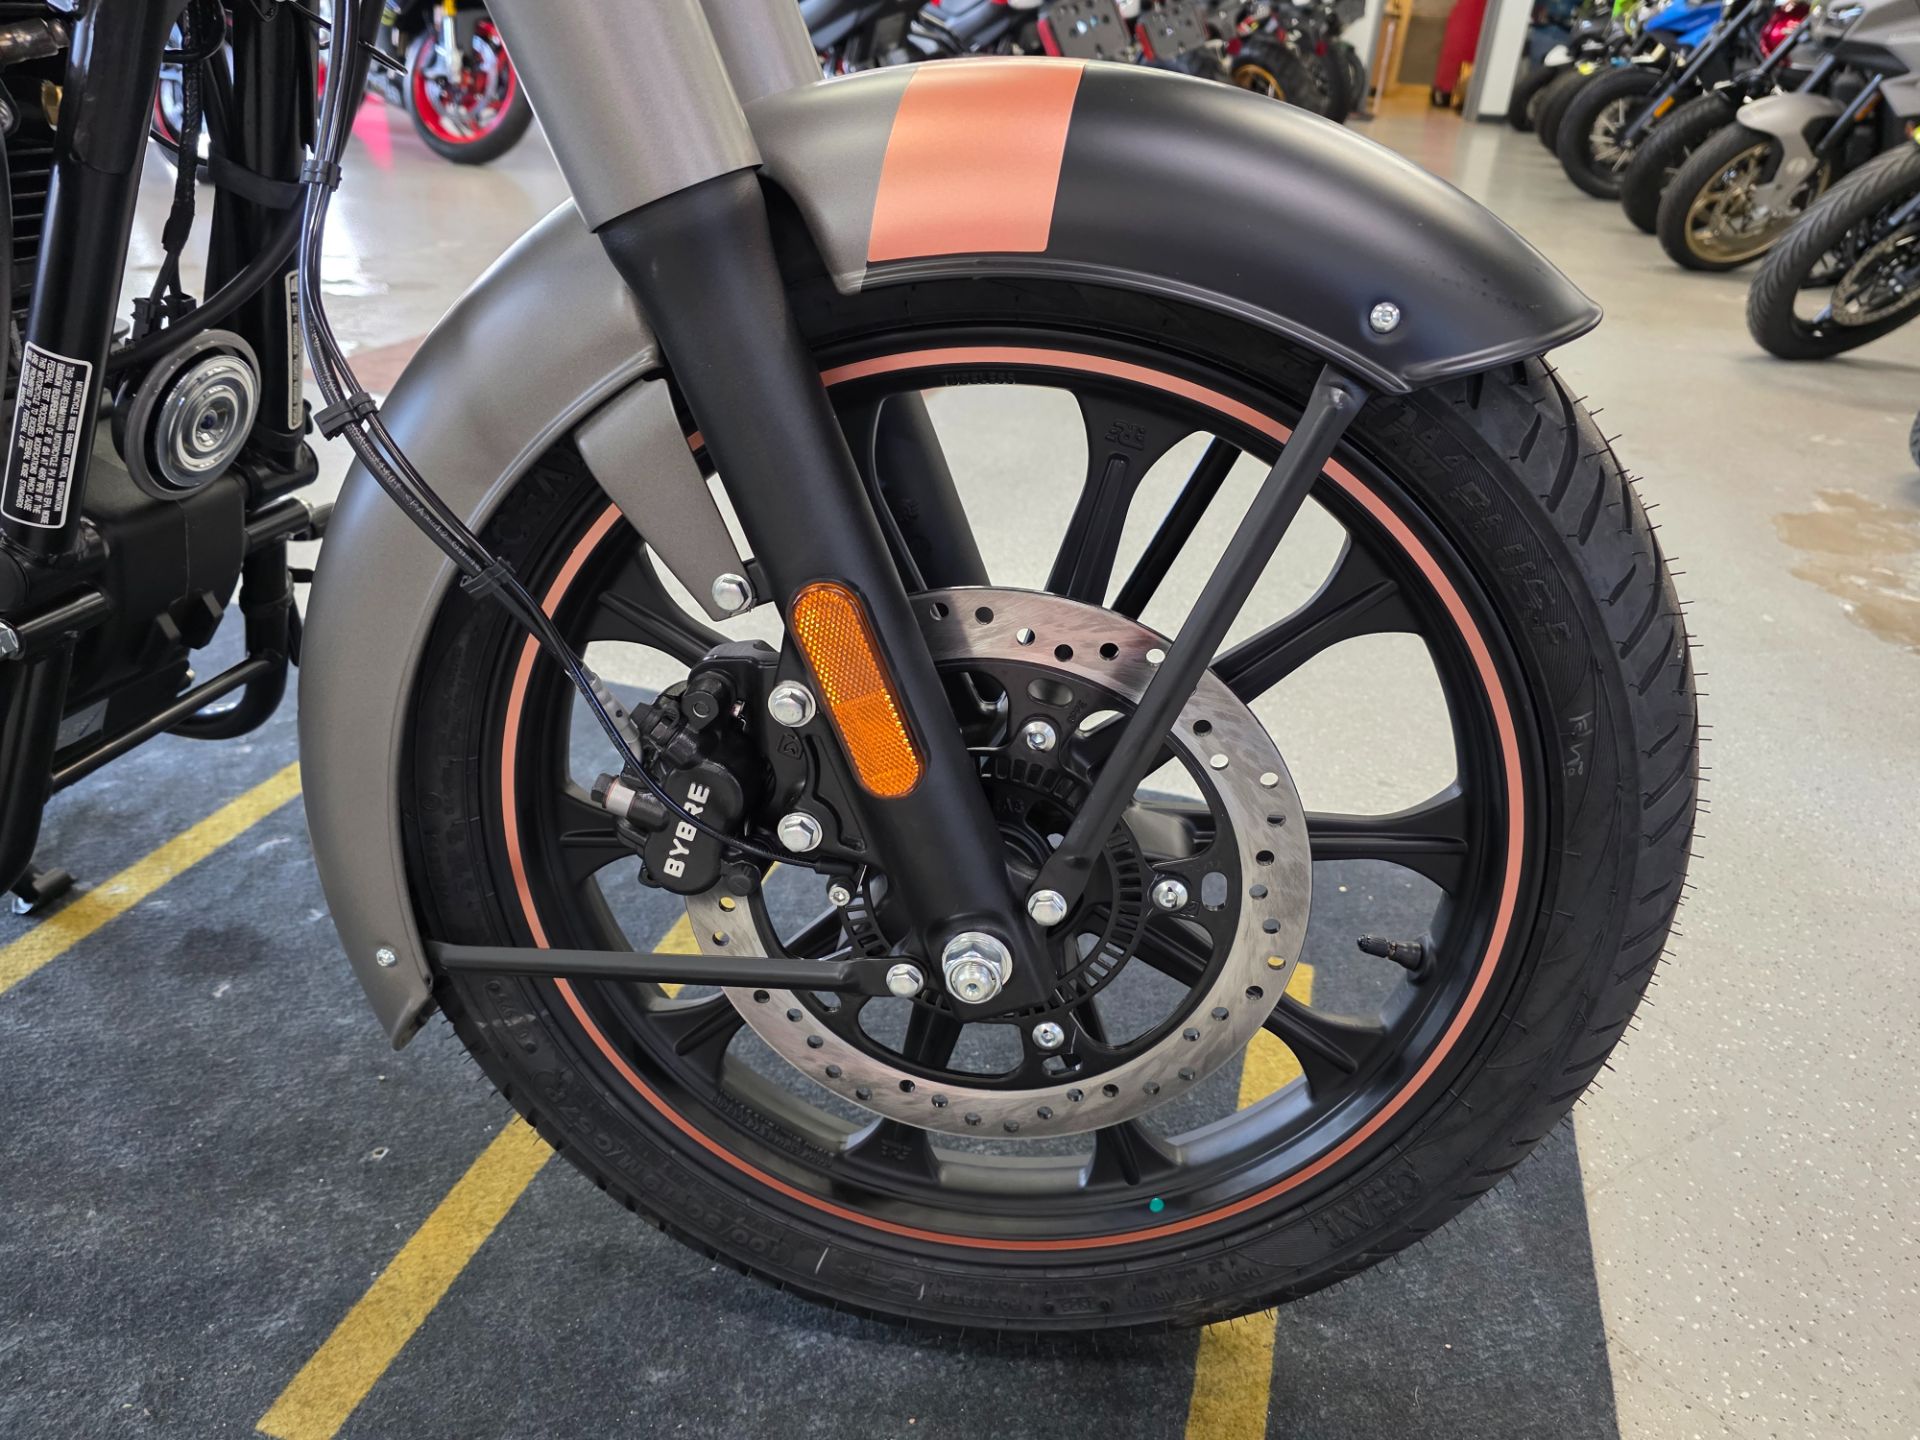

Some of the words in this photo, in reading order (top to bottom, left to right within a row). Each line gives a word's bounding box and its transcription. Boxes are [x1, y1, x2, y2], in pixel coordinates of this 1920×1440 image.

[37, 355, 47, 370] THIS
[43, 358, 56, 385] FEDERAL
[31, 368, 45, 406] MOTORCYCLE
[40, 385, 51, 402] TEST
[20, 407, 30, 433] FEDERAL
[26, 415, 37, 438] EXCEED
[22, 437, 34, 461] FEDERAL
[48, 431, 63, 468] MOTORCYCLE
[19, 461, 30, 478] NOISE
[14, 478, 27, 508] STANDARDS
[25, 475, 36, 493] WHICH
[44, 477, 56, 496] MEETS
[22, 493, 33, 511] CAUSE
[31, 502, 41, 514] THE
[663, 782, 710, 878] BYBRE
